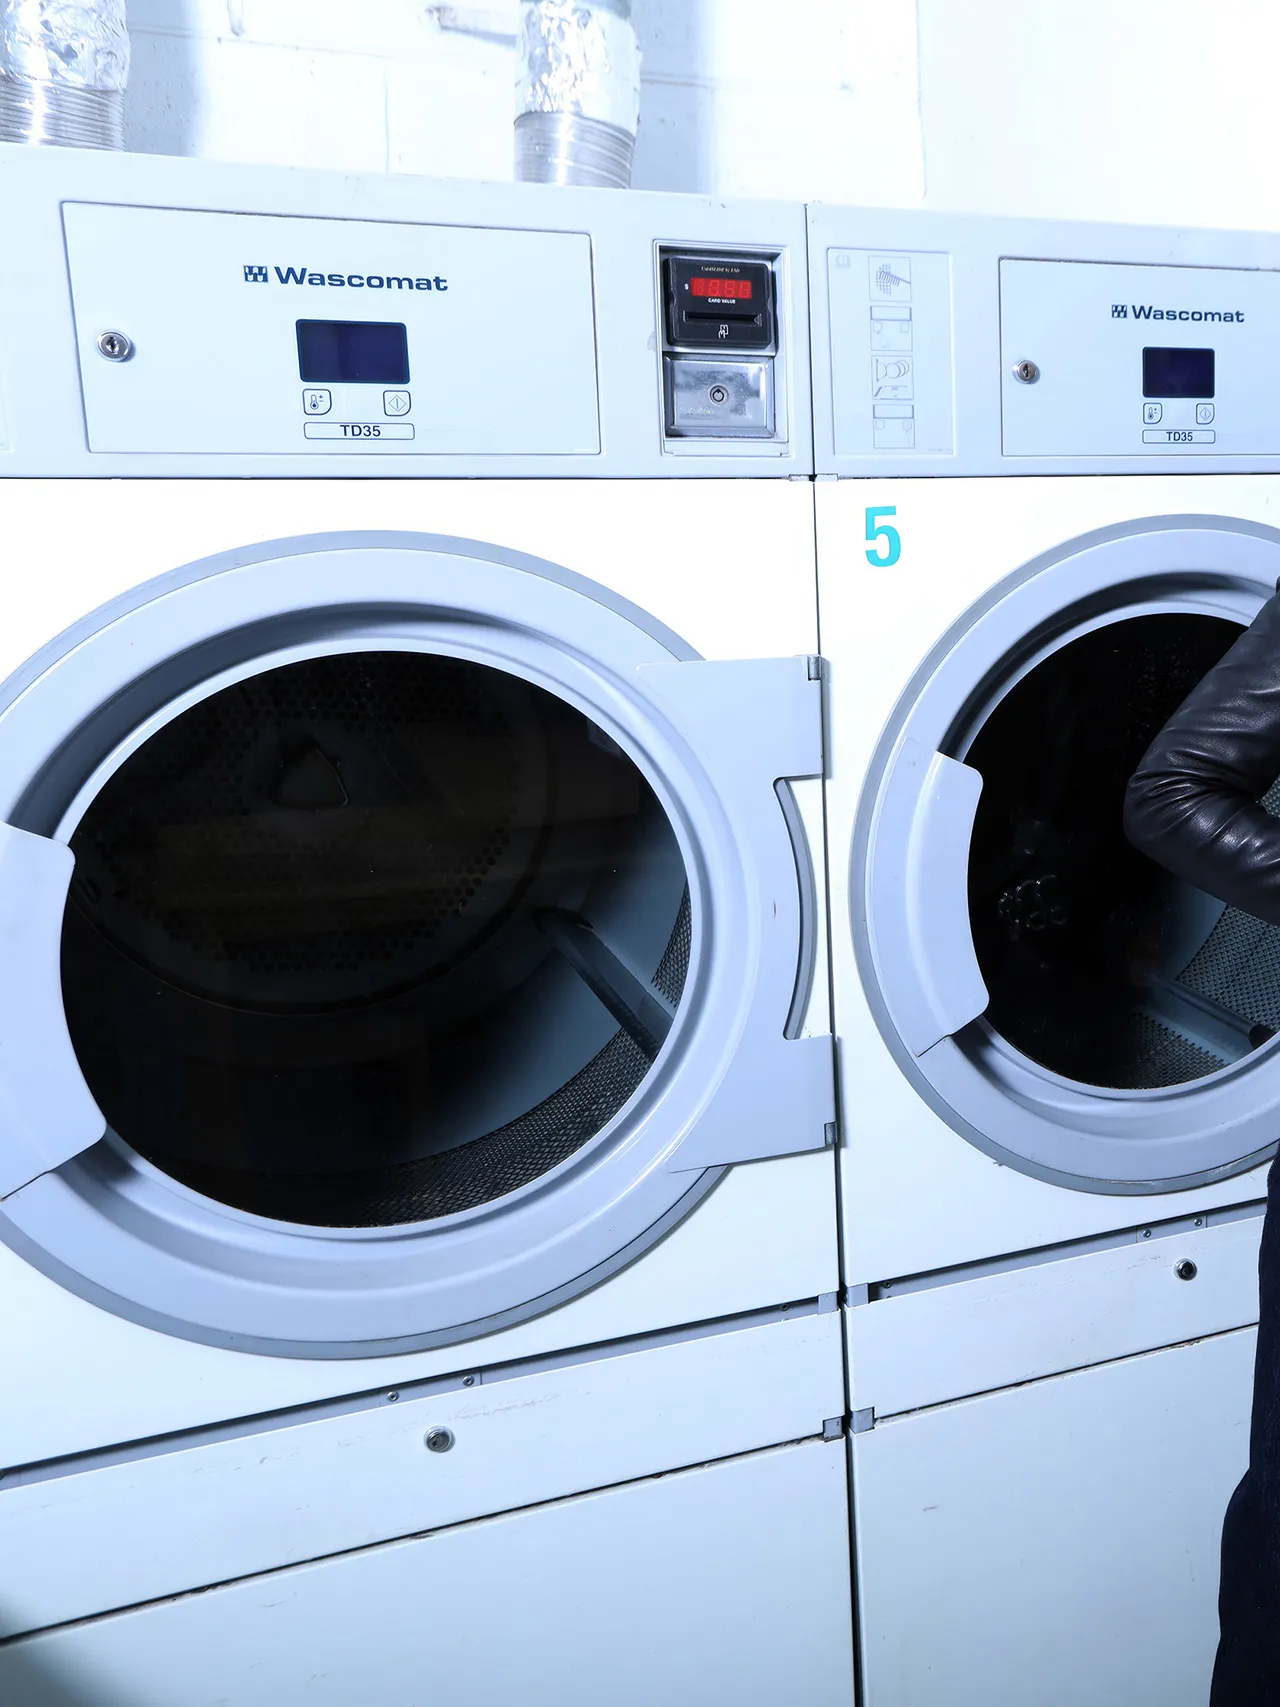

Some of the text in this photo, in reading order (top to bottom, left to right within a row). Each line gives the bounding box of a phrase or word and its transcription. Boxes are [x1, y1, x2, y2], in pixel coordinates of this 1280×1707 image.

[274, 266, 449, 292] Wascomat
[1131, 305, 1245, 322] Wascomat
[340, 424, 381, 437] TD35
[1166, 431, 1193, 442] TD35
[865, 505, 902, 567] 5
